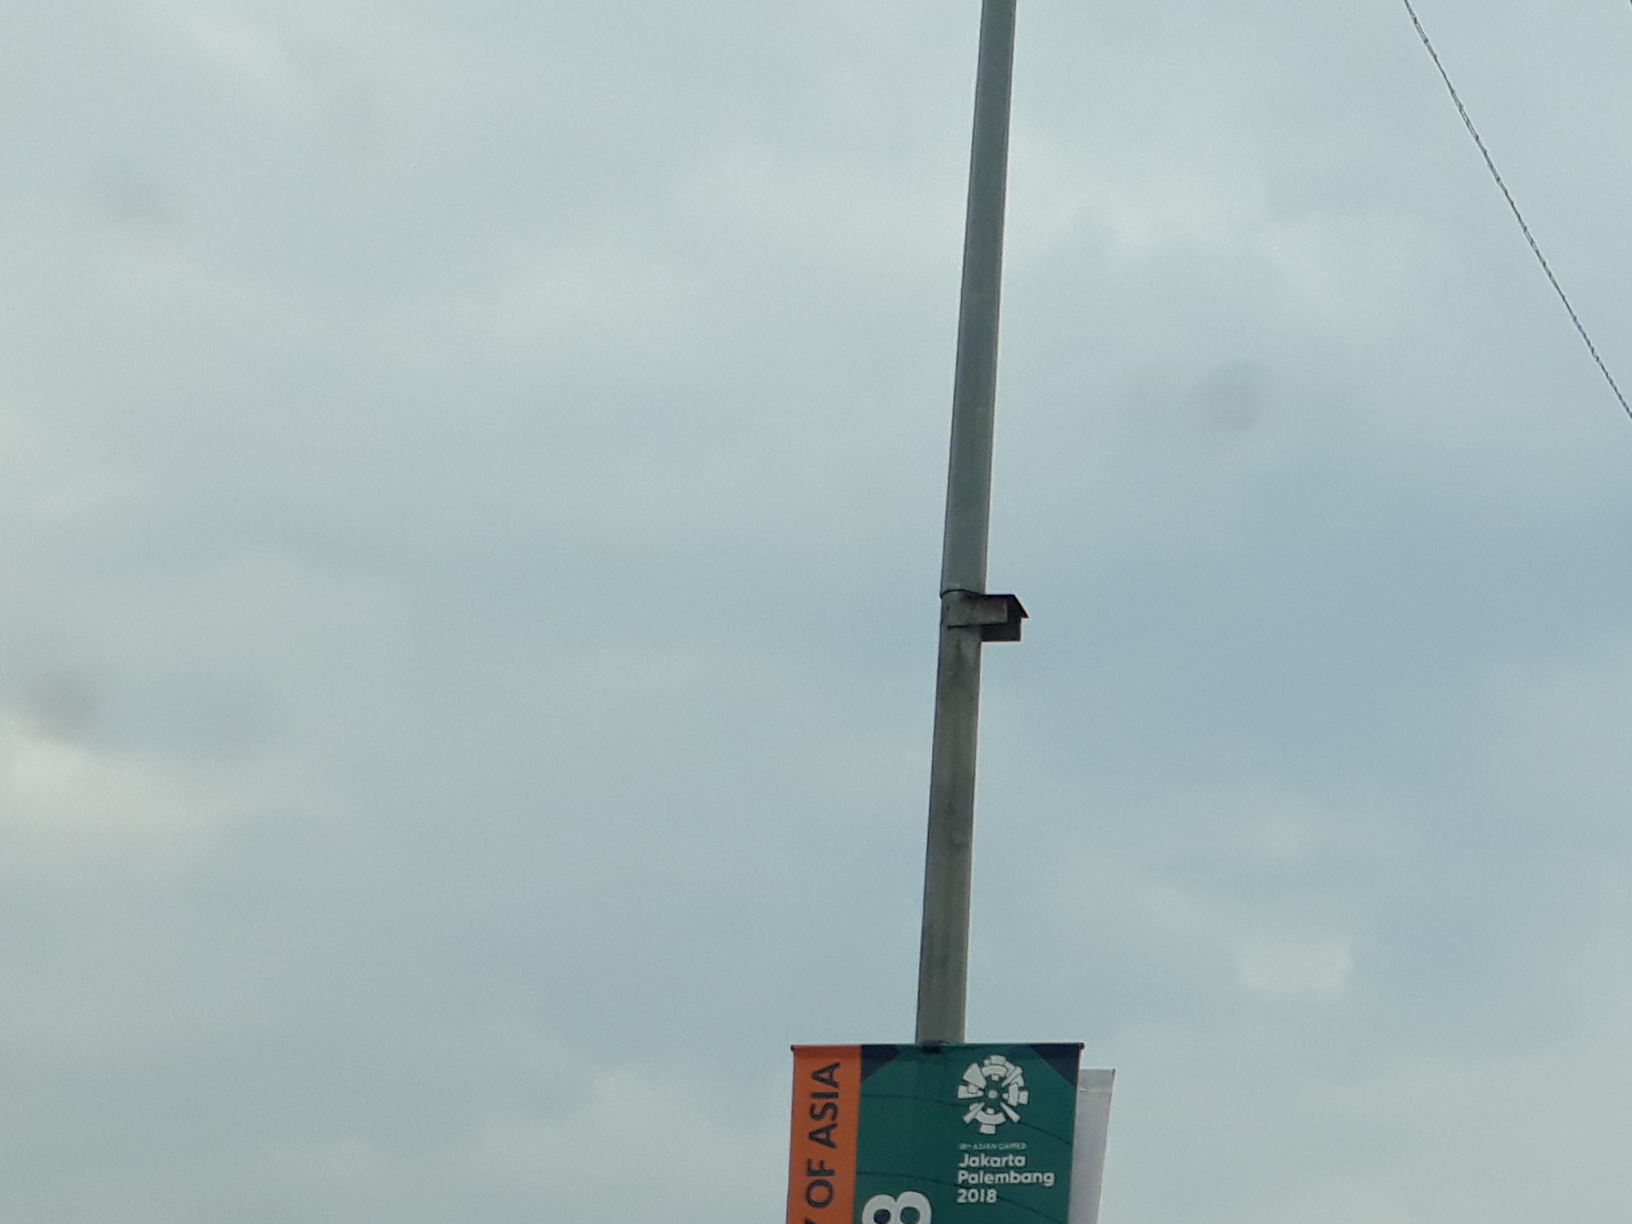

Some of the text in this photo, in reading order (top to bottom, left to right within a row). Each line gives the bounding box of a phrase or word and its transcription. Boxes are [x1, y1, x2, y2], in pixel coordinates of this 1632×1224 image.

[808, 1061, 841, 1149] ASIA
[958, 1153, 1026, 1168] Jakarta
[806, 1158, 834, 1208] OF
[957, 1170, 1056, 1187] Palembang
[956, 1188, 998, 1204] 2018
